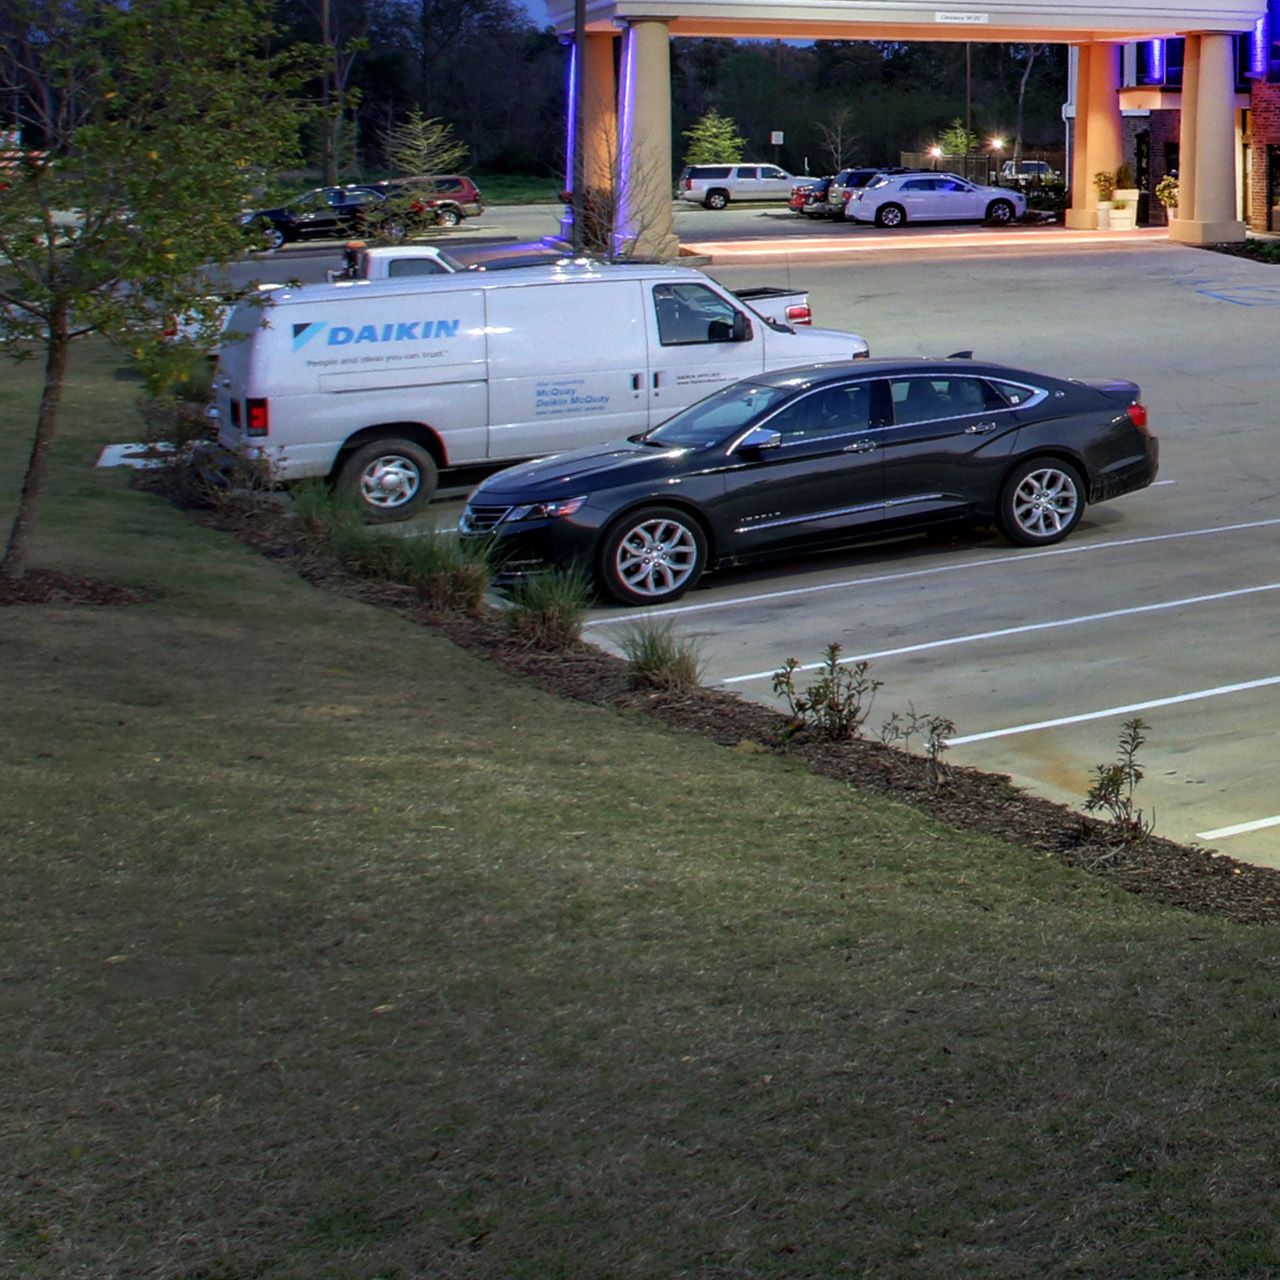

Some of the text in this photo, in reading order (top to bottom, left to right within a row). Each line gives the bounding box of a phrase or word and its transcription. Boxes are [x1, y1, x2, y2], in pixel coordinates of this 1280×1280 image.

[327, 319, 460, 346] DAIKIN
[307, 357, 338, 368] People
[340, 356, 358, 366] and
[385, 353, 404, 363] you
[404, 352, 421, 361] can
